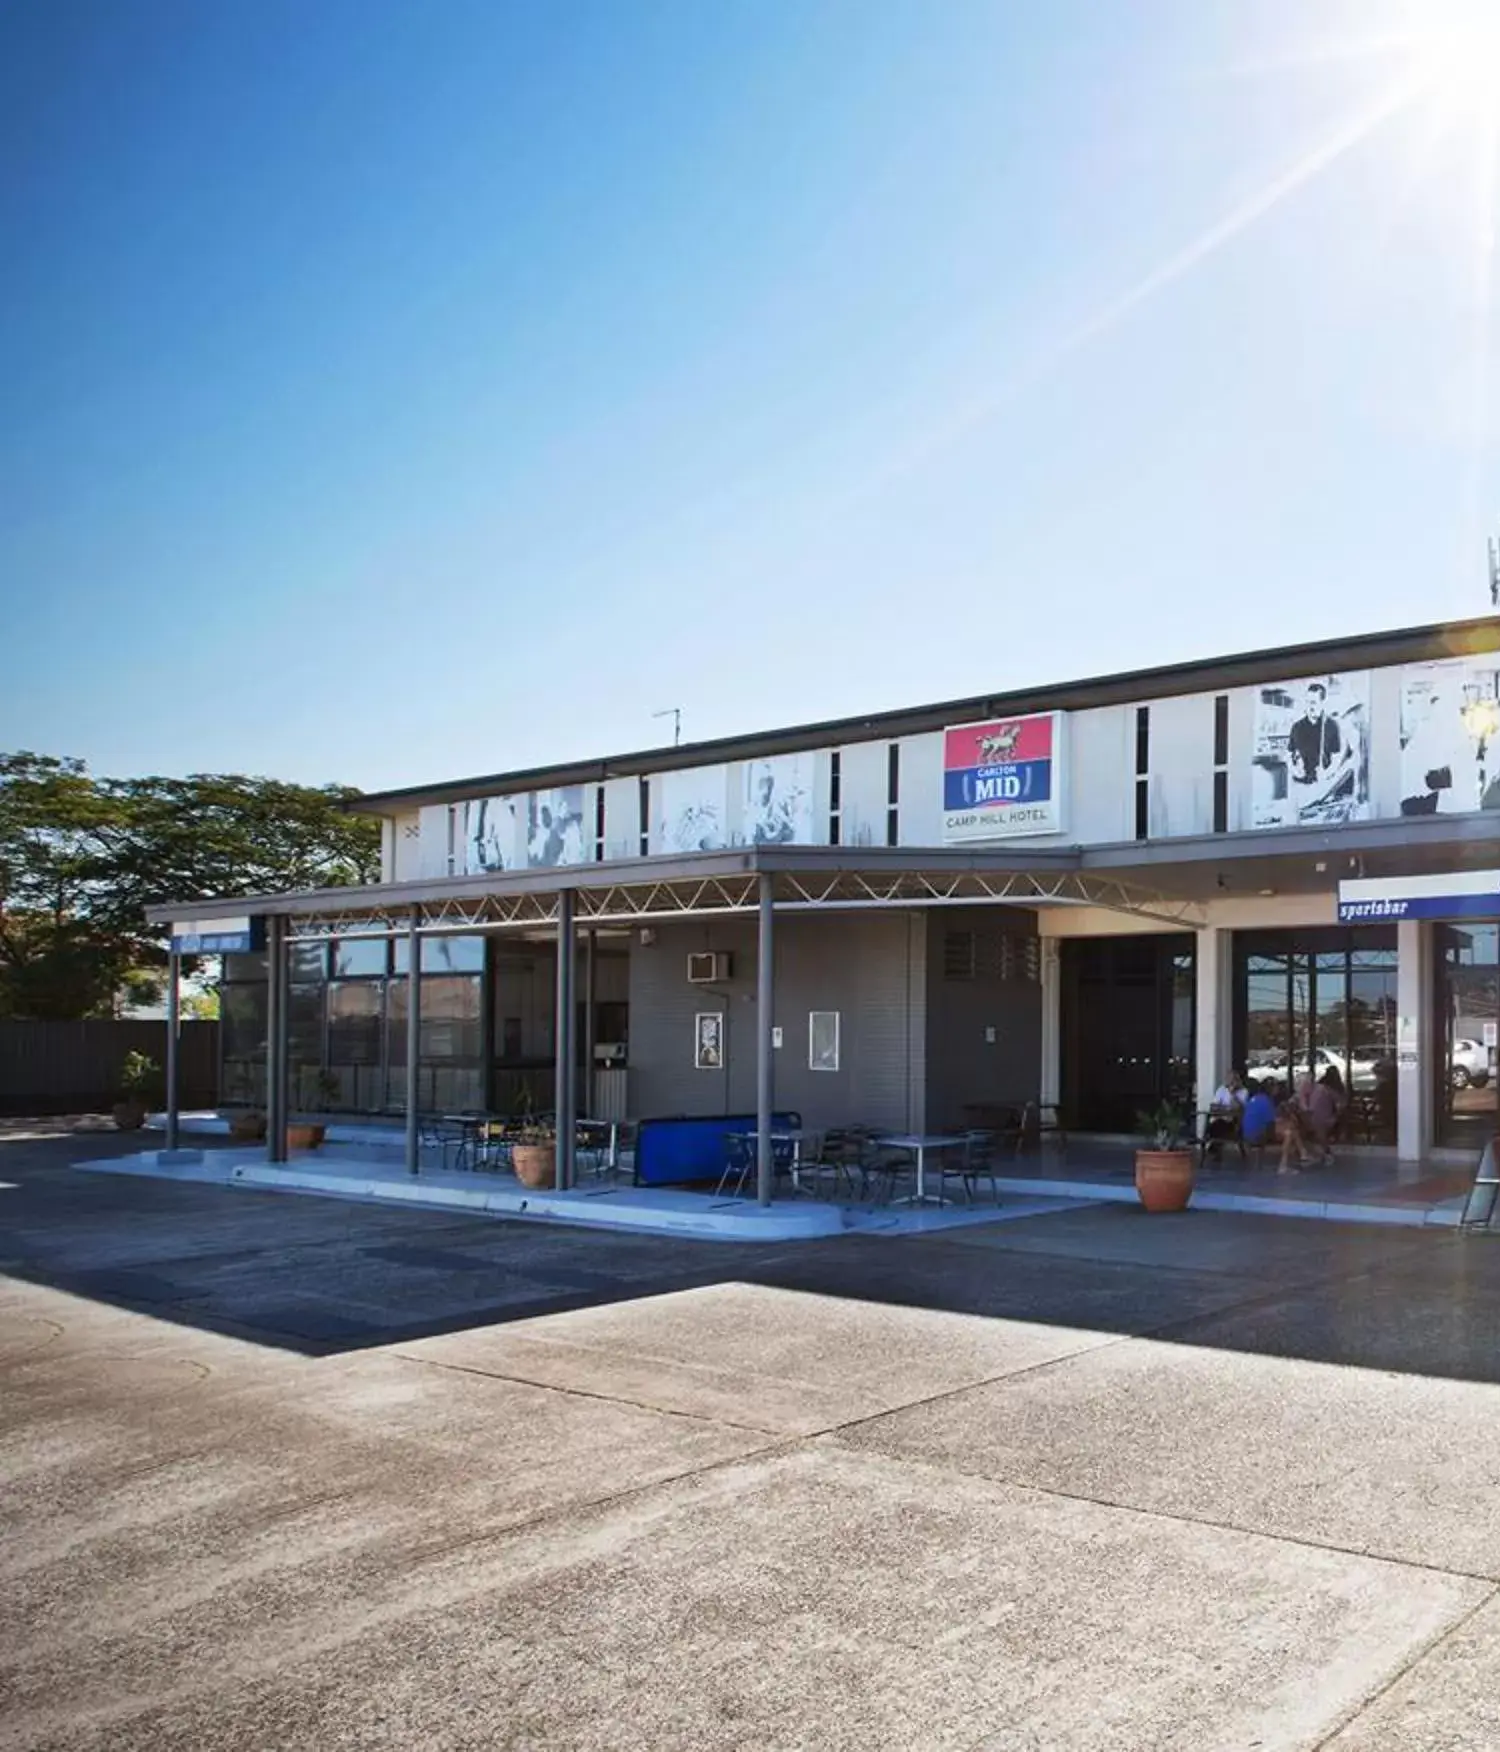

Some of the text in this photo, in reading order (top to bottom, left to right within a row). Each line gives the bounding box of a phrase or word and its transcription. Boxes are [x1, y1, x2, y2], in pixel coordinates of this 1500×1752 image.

[977, 765, 1017, 778] CARLTON
[974, 775, 1021, 803] MID
[946, 809, 1048, 828] CAMP HILL HOTEL
[1339, 899, 1409, 920] sportsbar
